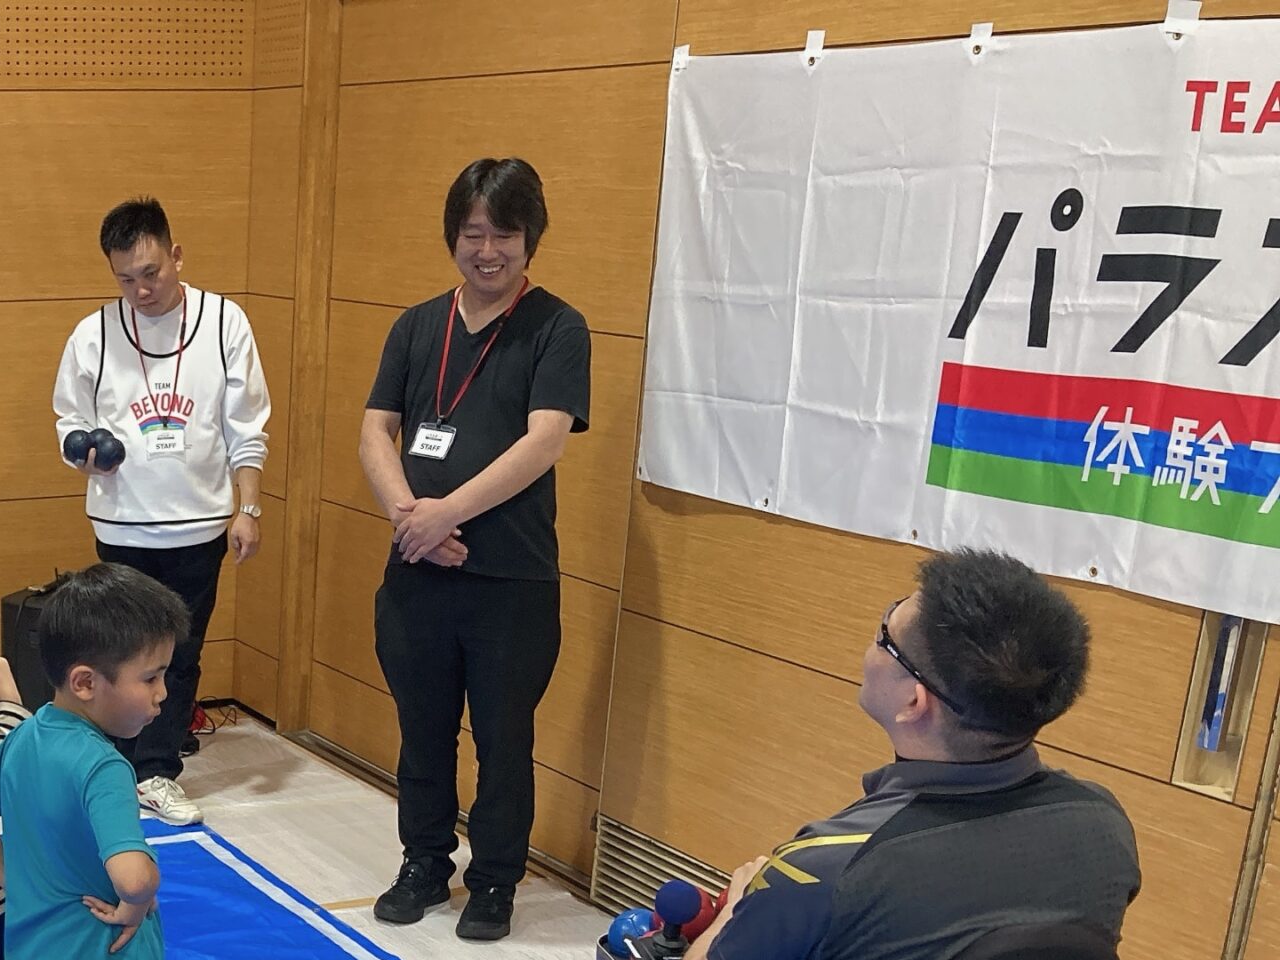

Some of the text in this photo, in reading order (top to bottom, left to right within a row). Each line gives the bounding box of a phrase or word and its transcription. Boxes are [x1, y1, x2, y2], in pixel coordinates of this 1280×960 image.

[154, 382, 171, 390] TEAM
[130, 393, 195, 420] BEYOND
[155, 442, 176, 450] STAFF
[420, 443, 441, 452] STAFF
